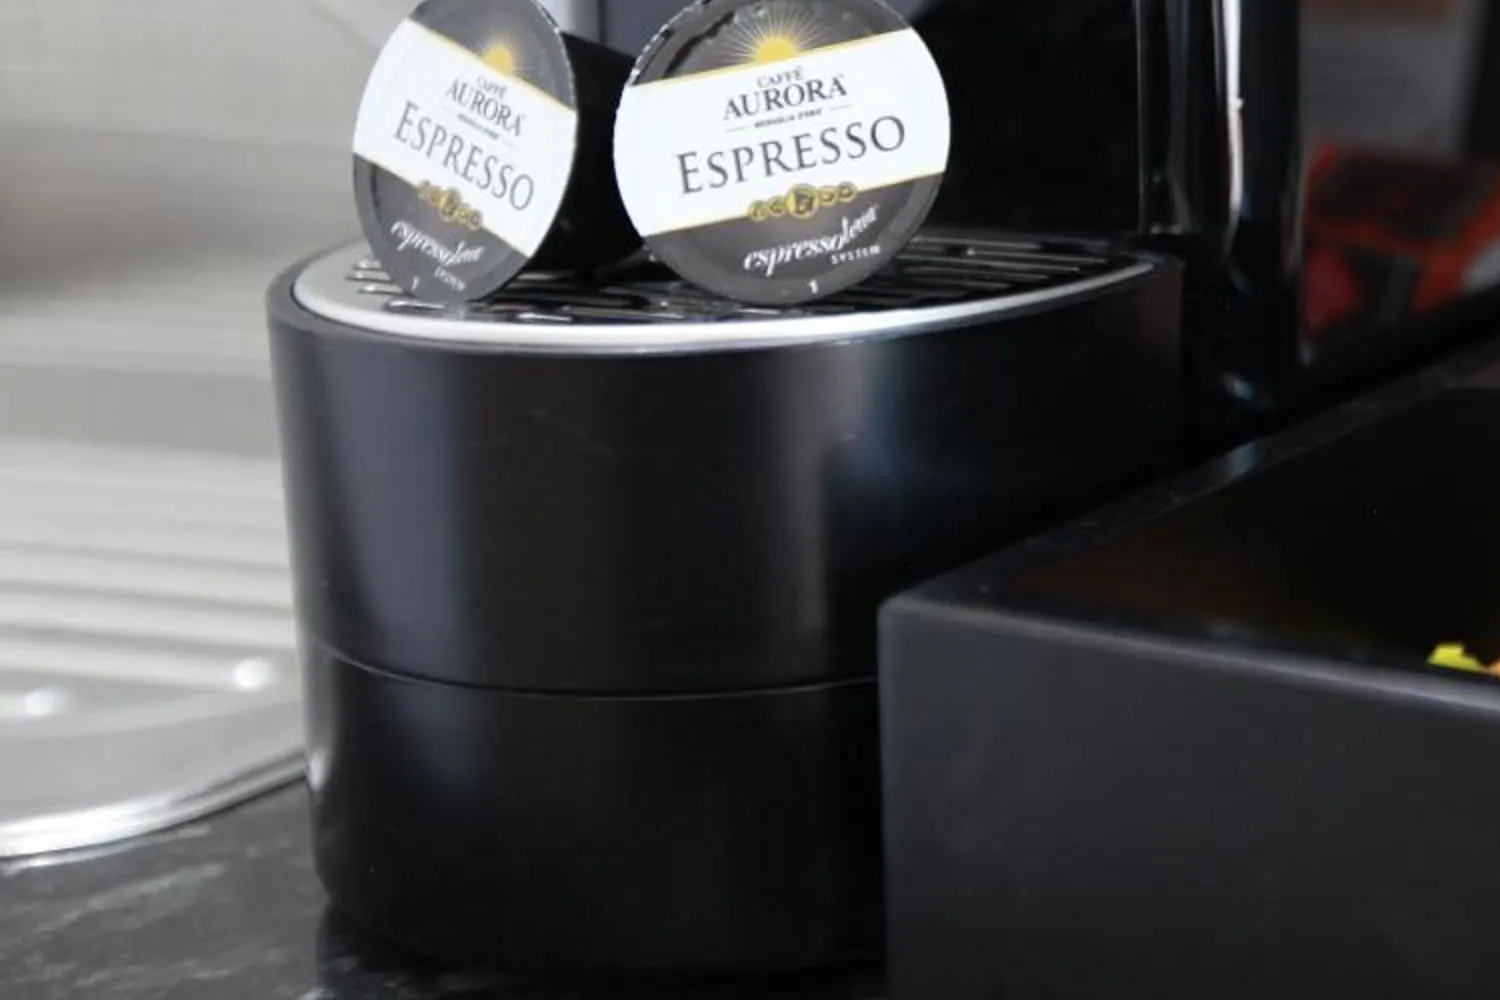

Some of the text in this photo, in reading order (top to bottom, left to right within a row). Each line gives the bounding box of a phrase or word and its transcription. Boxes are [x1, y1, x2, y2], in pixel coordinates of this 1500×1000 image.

[445, 79, 522, 137] AURORA
[724, 76, 848, 121] AURORA
[394, 100, 534, 210] ESPRESSO
[677, 115, 905, 195] ESPRESSO
